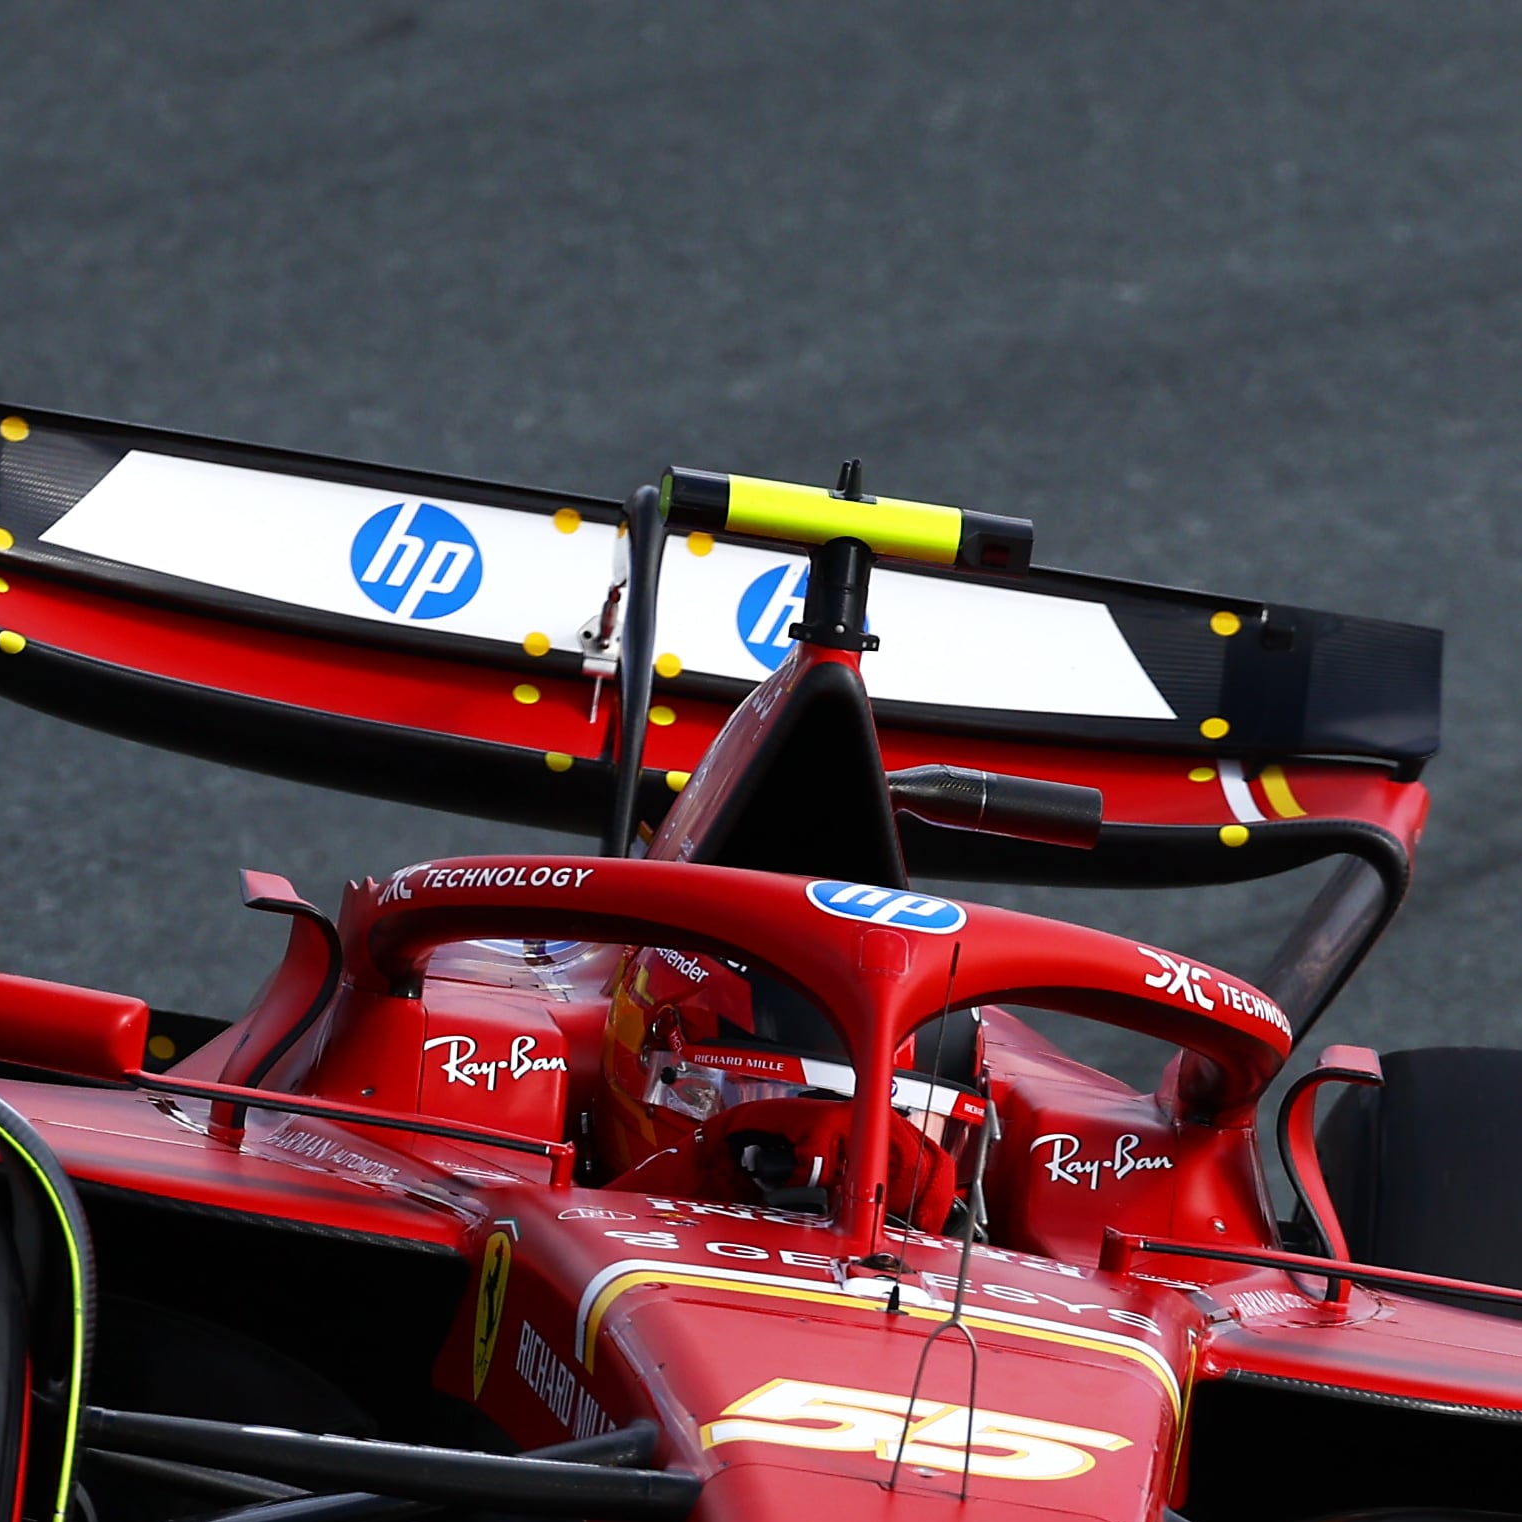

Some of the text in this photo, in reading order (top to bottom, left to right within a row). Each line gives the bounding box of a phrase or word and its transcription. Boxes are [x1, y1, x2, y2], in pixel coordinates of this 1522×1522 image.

[358, 502, 476, 620] hp
[423, 867, 594, 888] TECHNOLOGY
[828, 884, 948, 923] hp
[1137, 946, 1215, 1011] DXC
[423, 1035, 568, 1091] Ray-Ban
[694, 1054, 785, 1072] RICHARD MILLE
[1030, 1134, 1174, 1190] Ray-Ban
[516, 1319, 576, 1428] RICHARD
[700, 1377, 1134, 1480] 55
